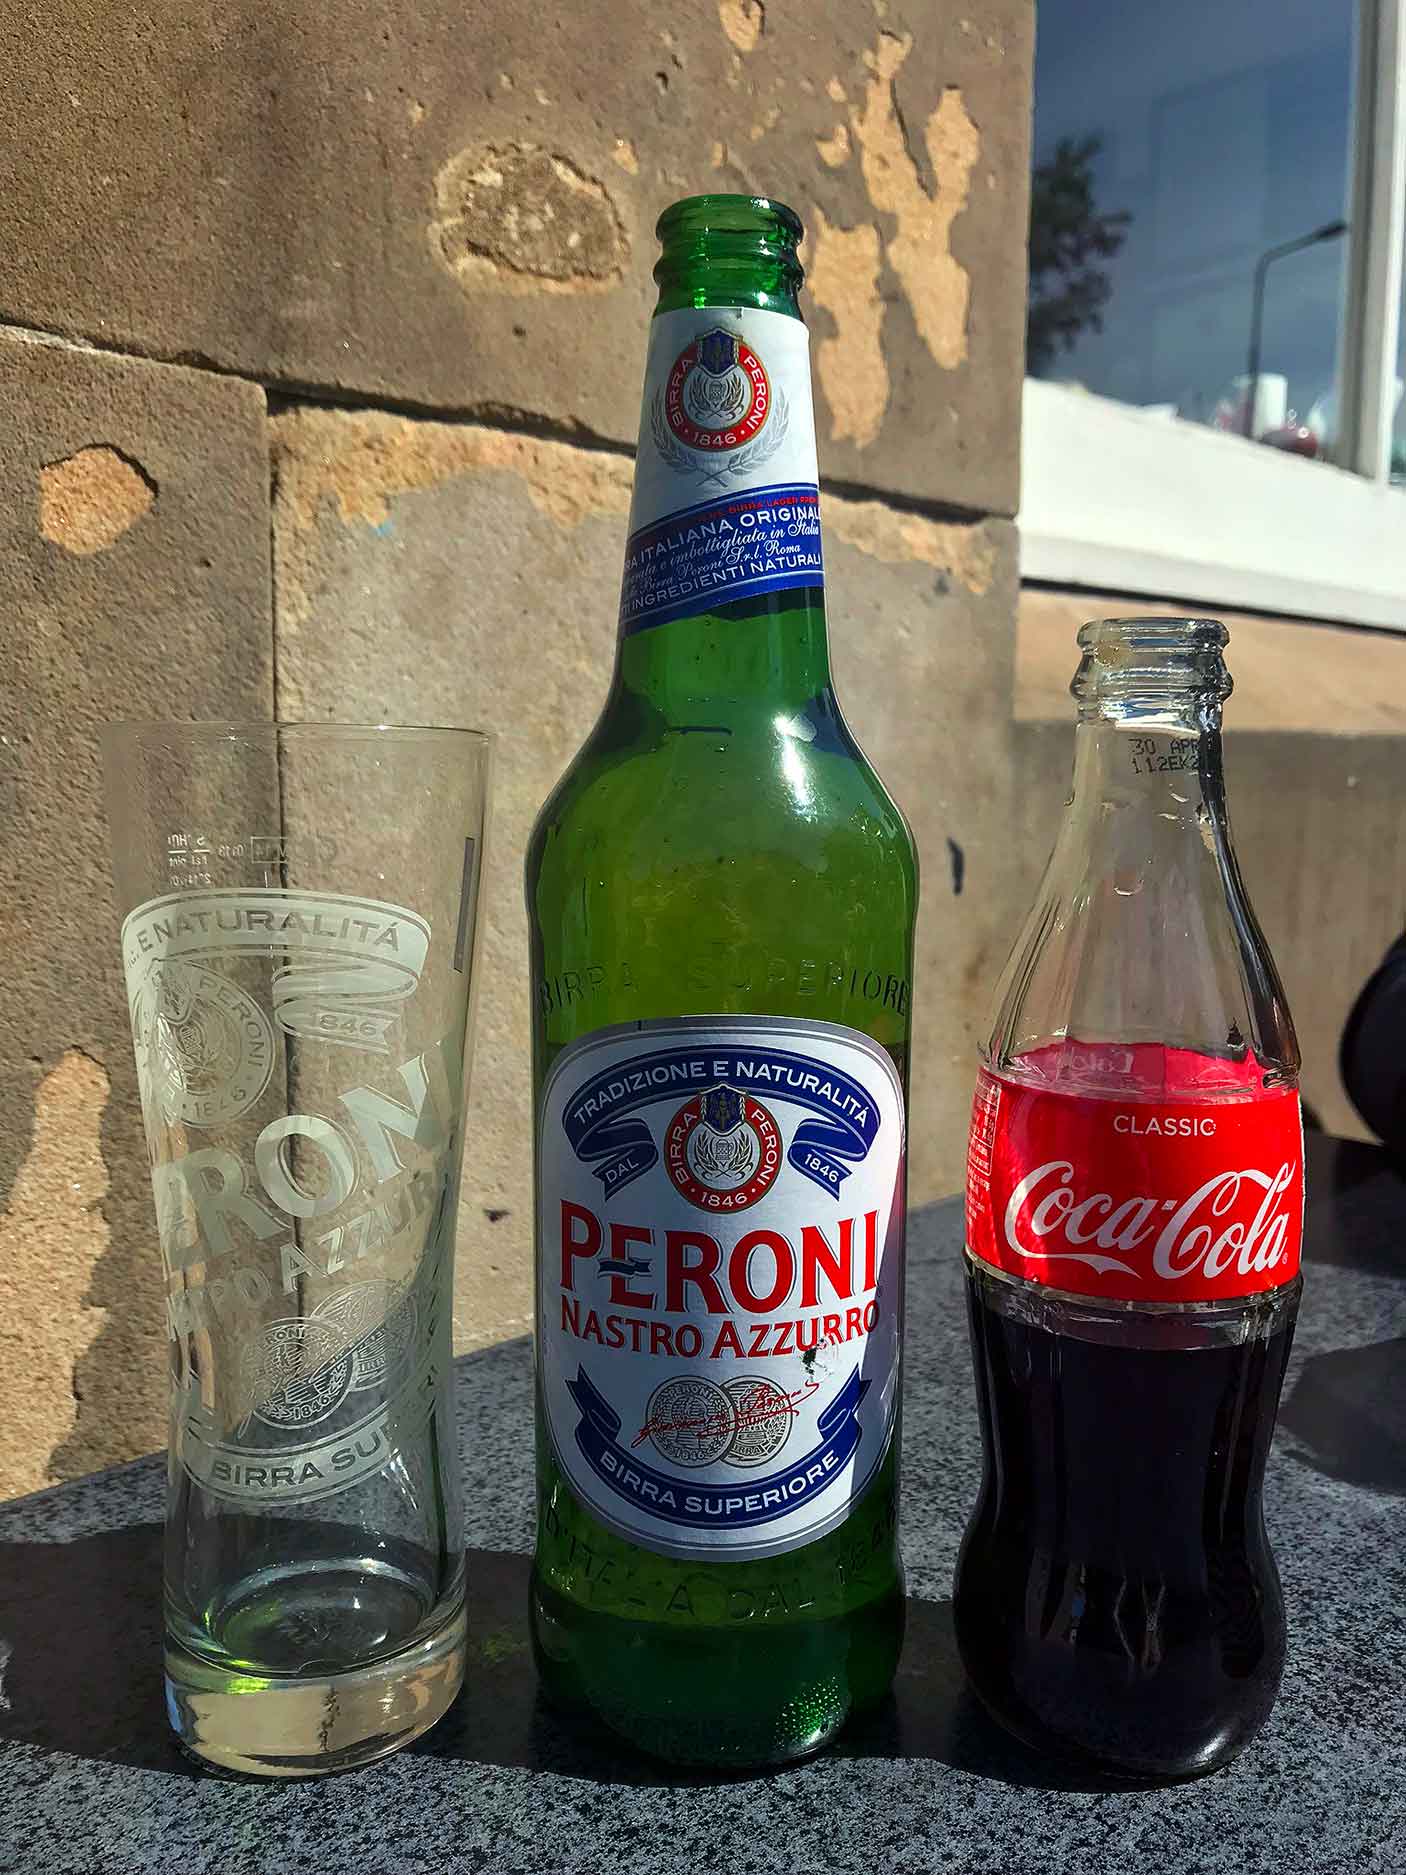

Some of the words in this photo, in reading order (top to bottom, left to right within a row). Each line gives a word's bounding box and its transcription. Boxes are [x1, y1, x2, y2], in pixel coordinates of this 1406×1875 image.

[667, 358, 694, 426] BIRRA
[744, 355, 768, 430] PERONI
[693, 432, 737, 446] 1846
[640, 519, 734, 563] ITALIANA
[763, 539, 801, 557] Roma
[769, 524, 786, 539] in
[632, 565, 745, 609] INGREDIENTI
[1128, 738, 1156, 755] 30
[573, 1061, 707, 1125] TRADIZIONE
[713, 1061, 729, 1077] E
[736, 1061, 869, 1129] NATURALITÁ
[1113, 1115, 1216, 1137] CLASSIC
[671, 1112, 698, 1185] BIRRA
[751, 1108, 778, 1187] PERONI
[605, 1157, 640, 1184] DAL
[803, 1153, 840, 1183] 1846
[701, 1191, 748, 1208] 1846
[1004, 1159, 1296, 1280] Coca-Cola
[559, 1199, 880, 1315] PERONI
[560, 1294, 700, 1358] NASTRO
[708, 1299, 881, 1360] AZZURRO
[211, 1462, 325, 1489] BIRRA
[600, 1450, 677, 1509] BIRRA
[684, 1449, 840, 1515] SUPERIORE
